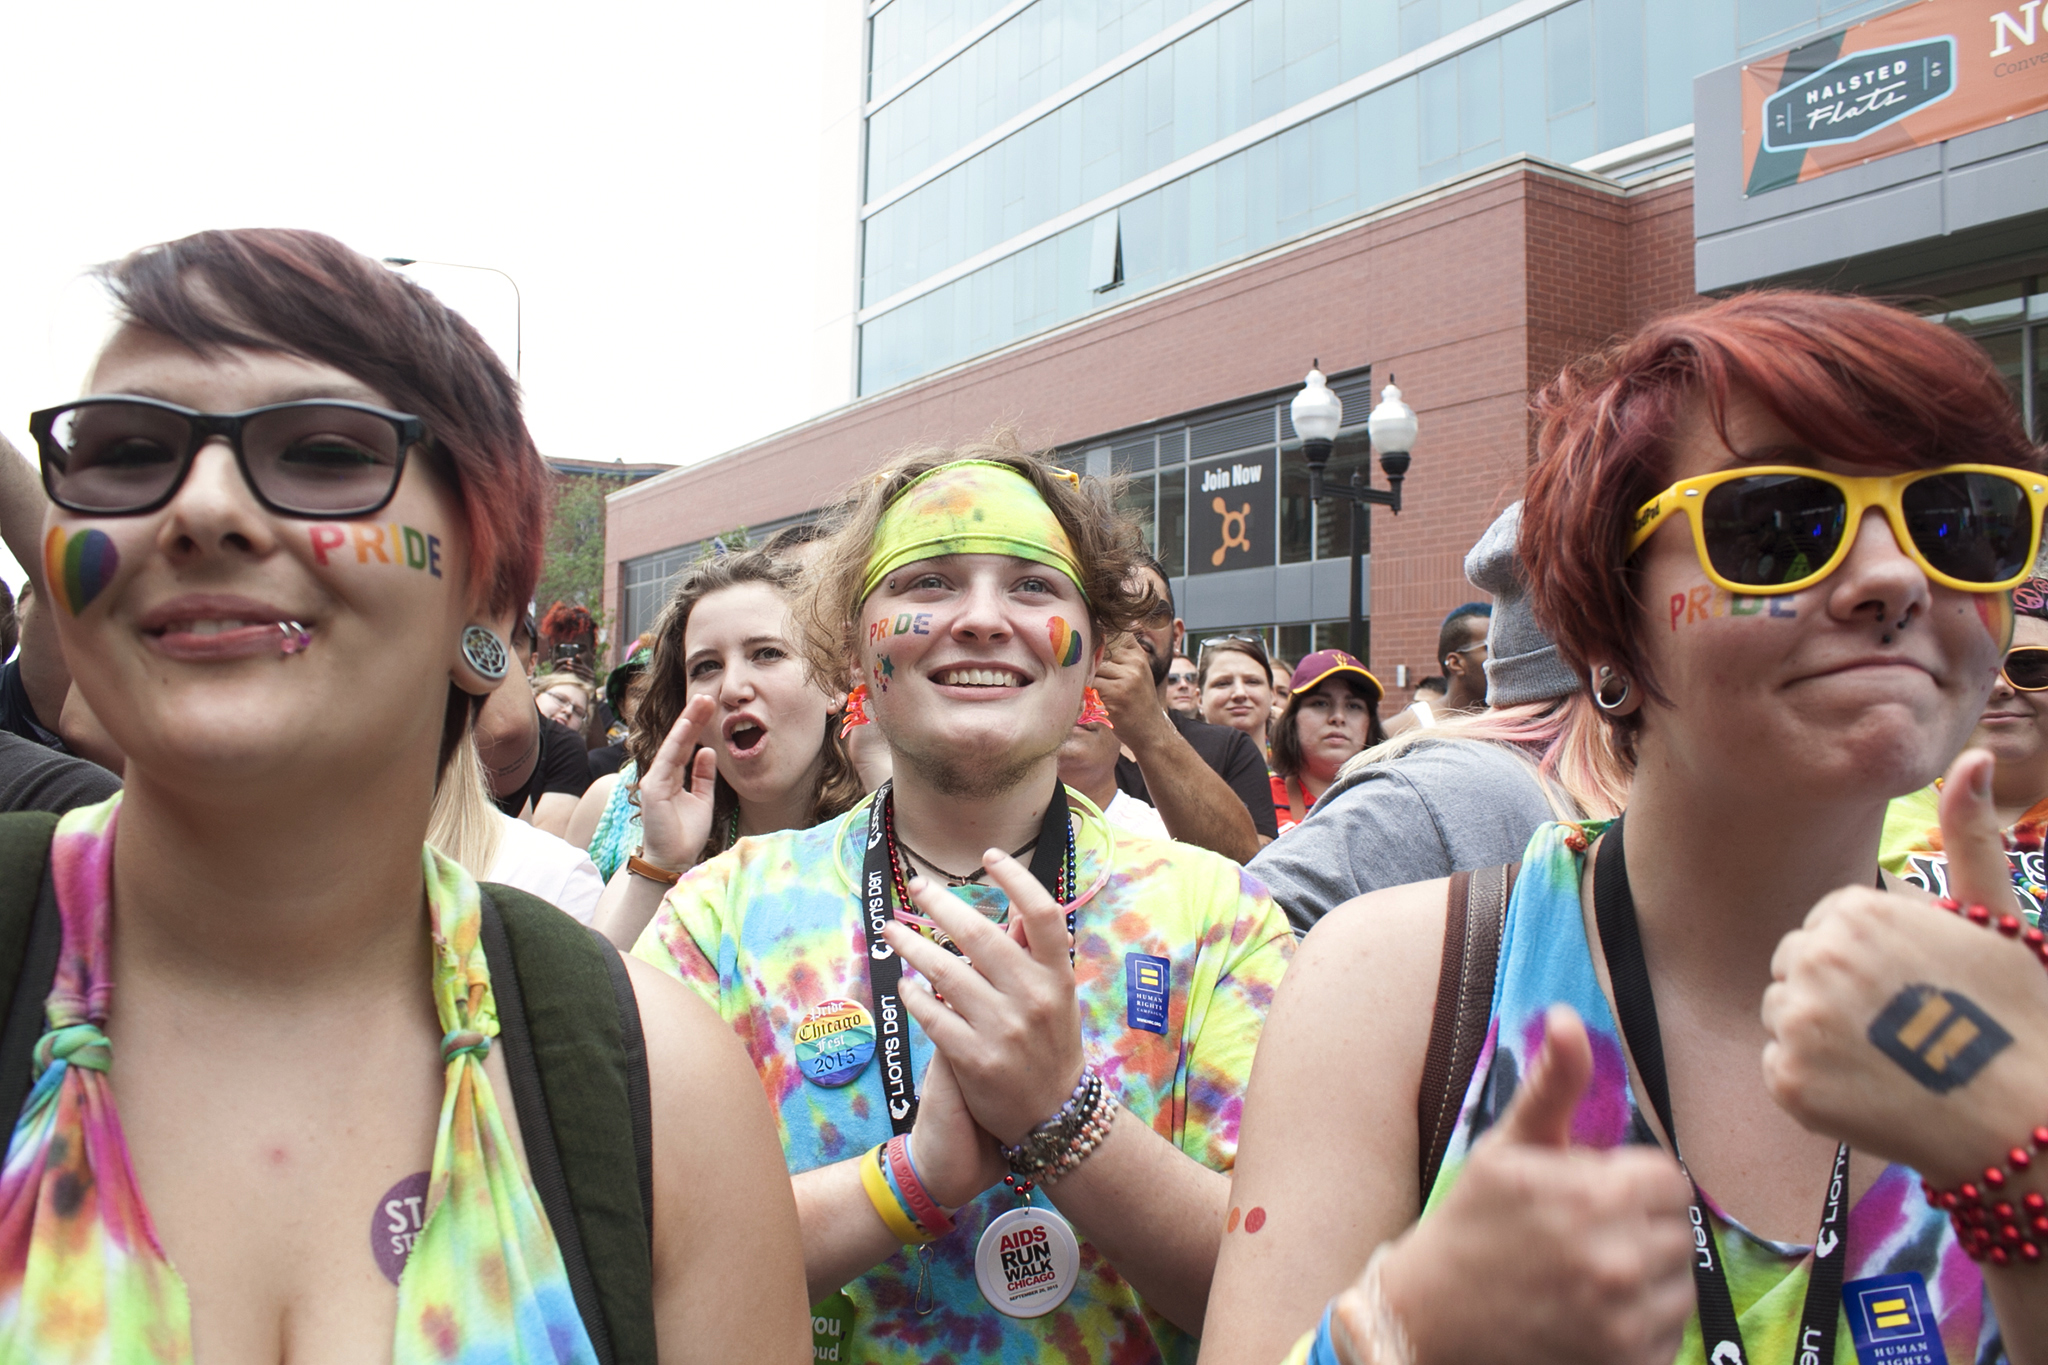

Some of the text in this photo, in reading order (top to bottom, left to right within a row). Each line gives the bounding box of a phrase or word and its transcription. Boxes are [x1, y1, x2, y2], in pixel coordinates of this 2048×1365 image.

[1989, 0, 2048, 57] N
[1806, 60, 1908, 104] HALSTED
[1806, 80, 1908, 130] Flats
[1201, 463, 1262, 492] Join Now
[308, 523, 443, 579] PRIDE
[1671, 584, 1797, 633] PRIDE
[869, 612, 933, 647] PRIDE
[809, 1001, 845, 1022] Pride
[1136, 992, 1163, 1004] HUMAN
[1136, 1000, 1163, 1011] RIGHTS
[799, 1014, 861, 1041] Chicago
[815, 1034, 845, 1055] Fest
[814, 1049, 856, 1074] 2015
[385, 1196, 422, 1233] ST
[391, 1233, 418, 1255] ST
[1000, 1225, 1047, 1252] AIDS
[1000, 1241, 1051, 1271] RUN
[1004, 1258, 1054, 1282] WALK
[1007, 1271, 1056, 1291] CHICAGO
[1009, 1289, 1038, 1301] SEPTEMBER
[1874, 1341, 1928, 1358] HUMAN
